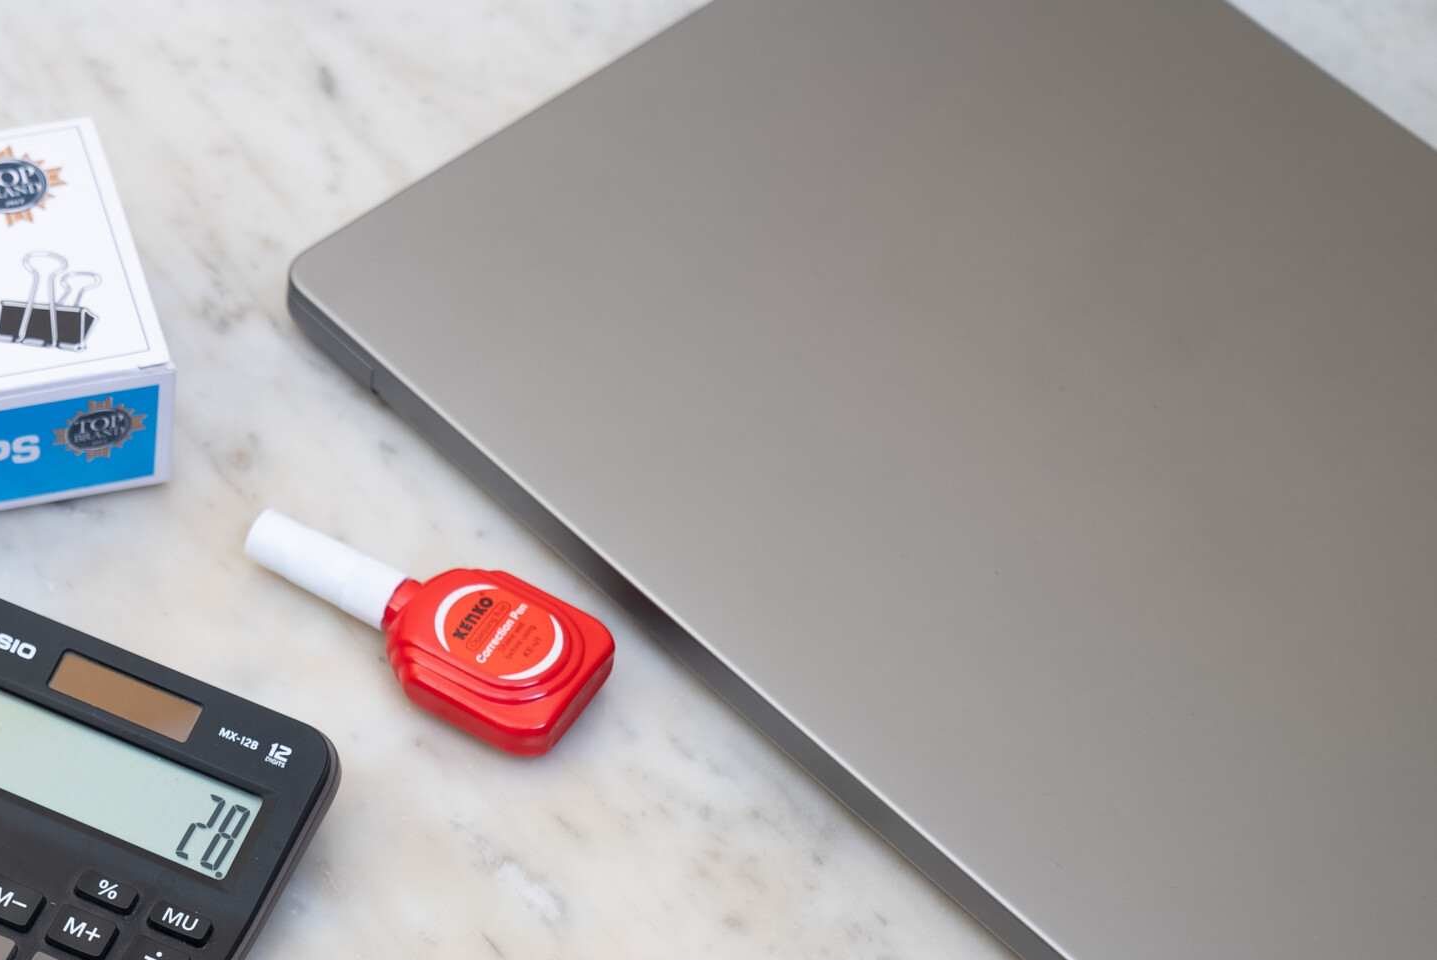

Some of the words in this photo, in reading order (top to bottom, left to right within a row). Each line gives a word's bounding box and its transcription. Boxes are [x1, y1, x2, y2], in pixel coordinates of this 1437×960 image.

[74, 412, 124, 436] TOP
[476, 616, 515, 664] Correction
[510, 603, 529, 621] Pen
[218, 727, 259, 750] MX-12B
[264, 755, 286, 769] DIGITS
[268, 743, 293, 763] 12
[63, 917, 101, 942] M+
[162, 907, 199, 932] MU
